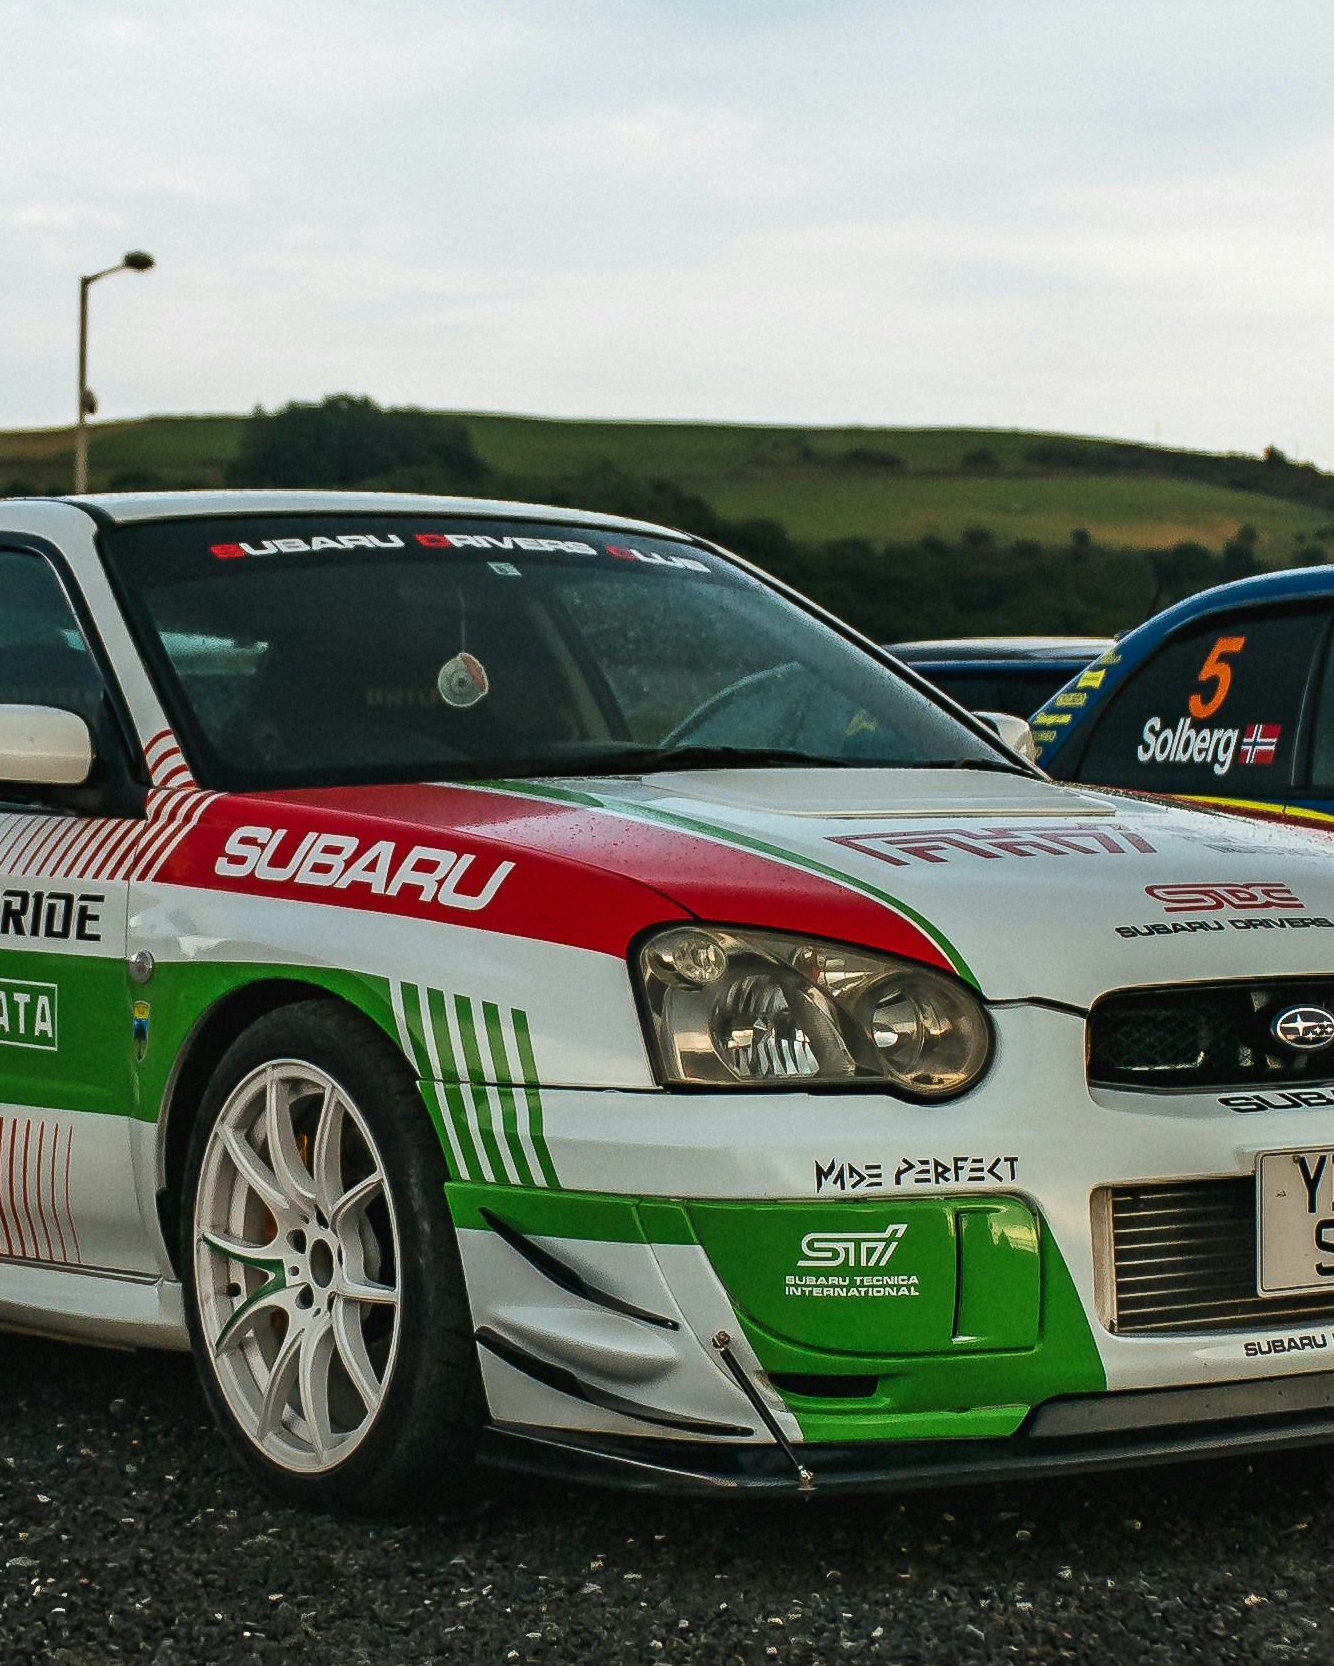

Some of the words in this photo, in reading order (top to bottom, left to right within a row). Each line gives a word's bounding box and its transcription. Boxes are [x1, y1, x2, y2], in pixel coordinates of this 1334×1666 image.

[1188, 636, 1246, 719] 5
[1137, 717, 1240, 776] Solberg
[214, 825, 517, 911] SUBARU
[1114, 919, 1225, 939] SUBARU
[814, 1157, 883, 1194] MADE
[894, 1156, 1019, 1186] PERFECT
[785, 1275, 850, 1286] SUBARU
[854, 1275, 920, 1286] TECNICA
[785, 1286, 920, 1297] INTERNATIONAL
[1244, 1333, 1328, 1357] SUBARU
